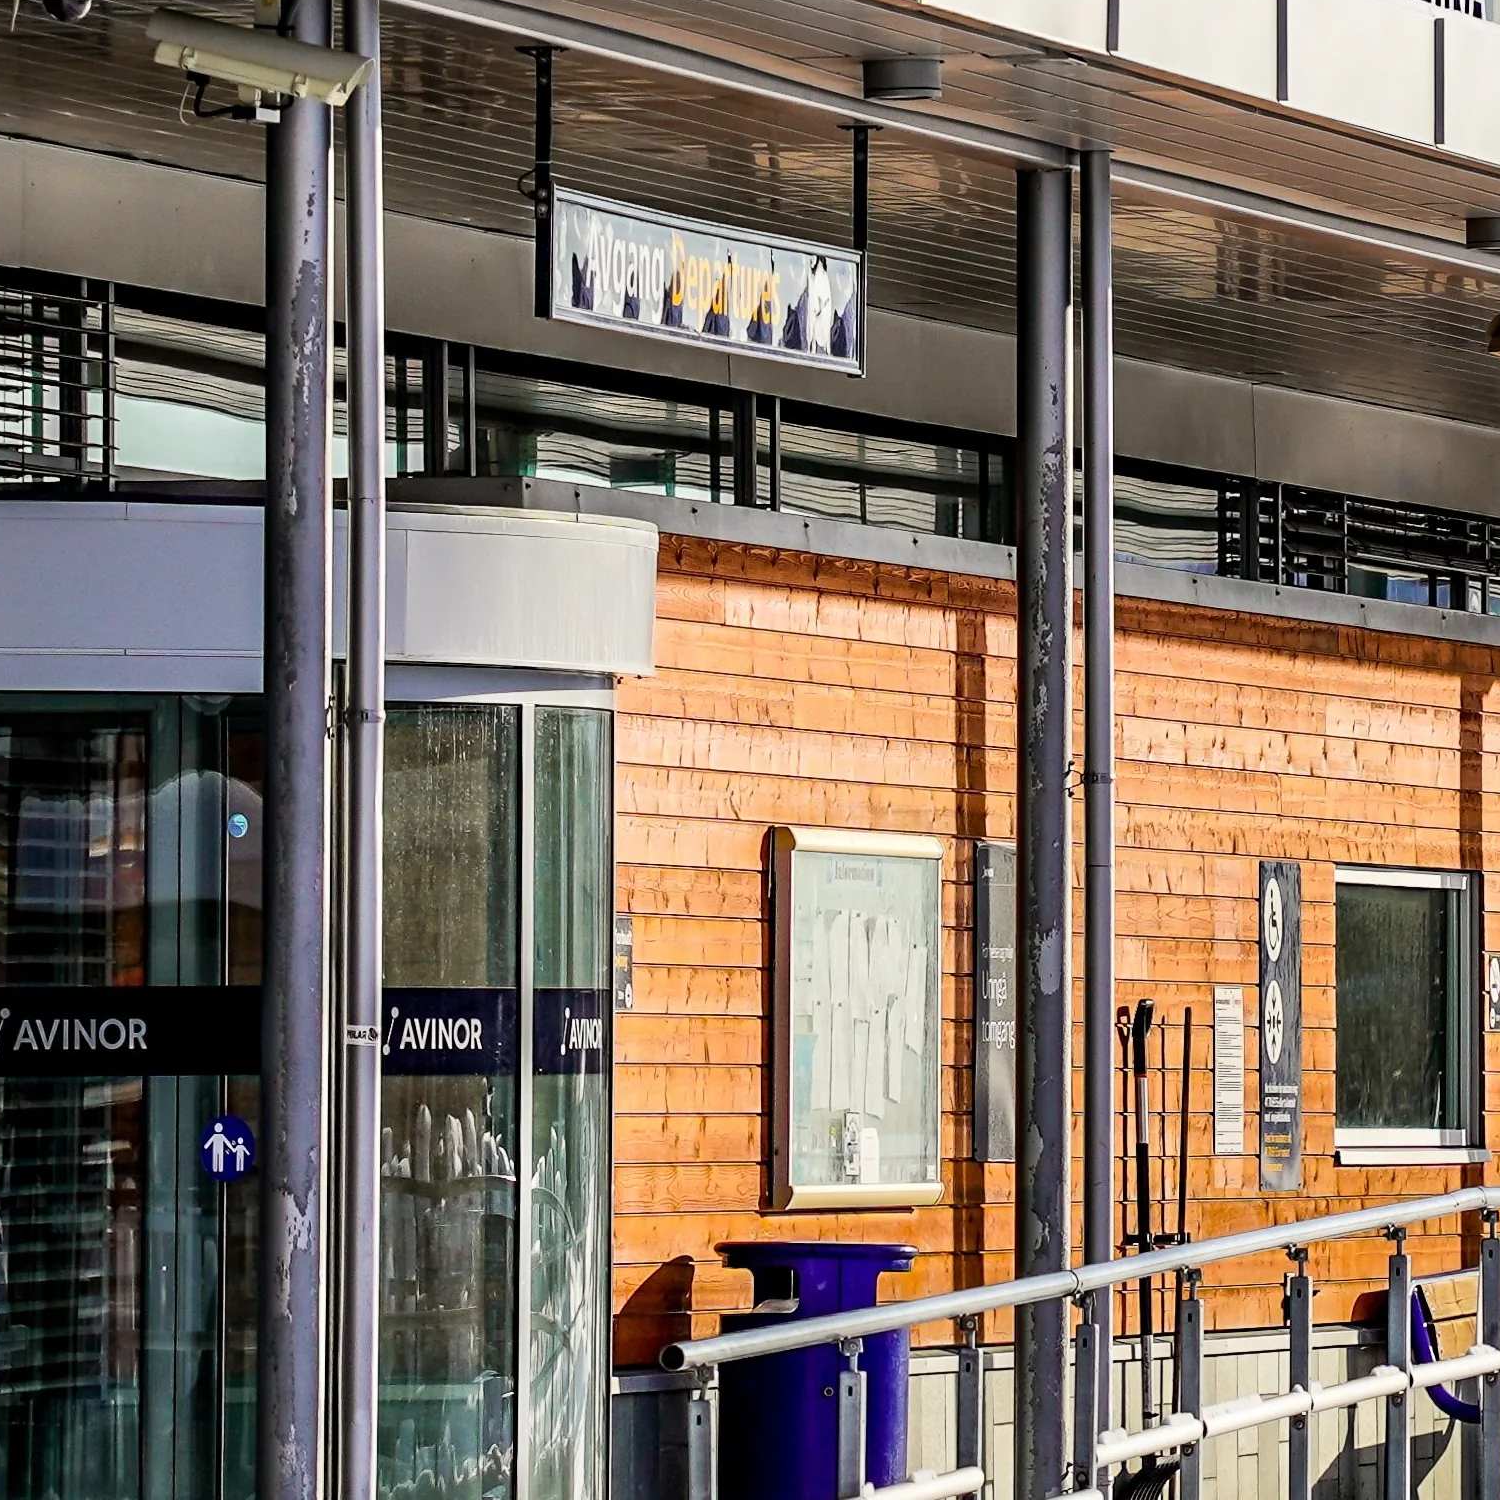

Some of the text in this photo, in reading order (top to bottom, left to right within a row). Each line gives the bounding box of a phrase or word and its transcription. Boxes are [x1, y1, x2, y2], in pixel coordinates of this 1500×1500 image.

[585, 222, 782, 334] Avgang Departures
[13, 1018, 148, 1050] AVINOR
[399, 1018, 483, 1050] AVINOR
[568, 1018, 603, 1050] AVINOR
[981, 1016, 1016, 1050] tomgang
